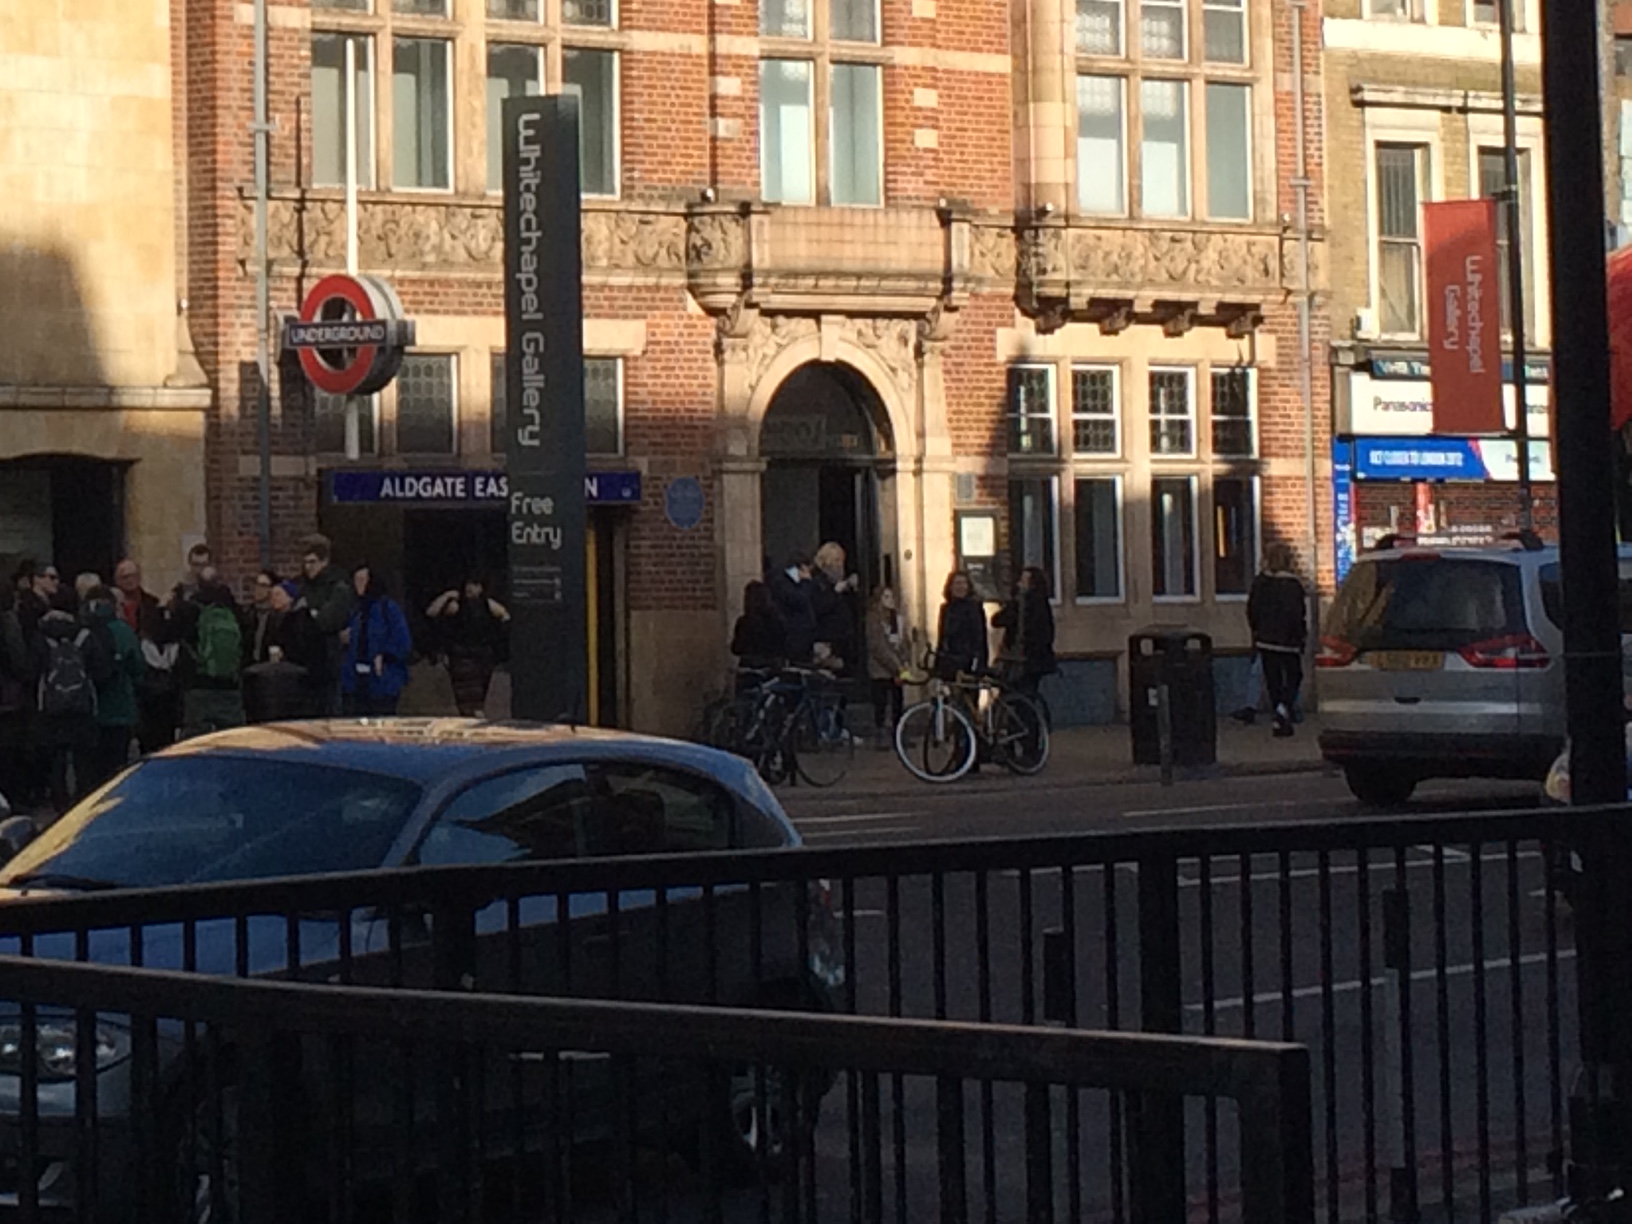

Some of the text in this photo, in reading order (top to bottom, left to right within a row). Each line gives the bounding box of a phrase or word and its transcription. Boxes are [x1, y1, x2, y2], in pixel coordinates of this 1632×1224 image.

[516, 113, 545, 447] Whitechapel Gallery
[1442, 285, 1461, 349] Gallery
[1465, 255, 1486, 372] Whitechapel
[291, 324, 385, 343] UNDERGROUND
[380, 477, 509, 498] ALDGATE EAS
[511, 492, 555, 515] Free
[511, 522, 563, 550] Entry
